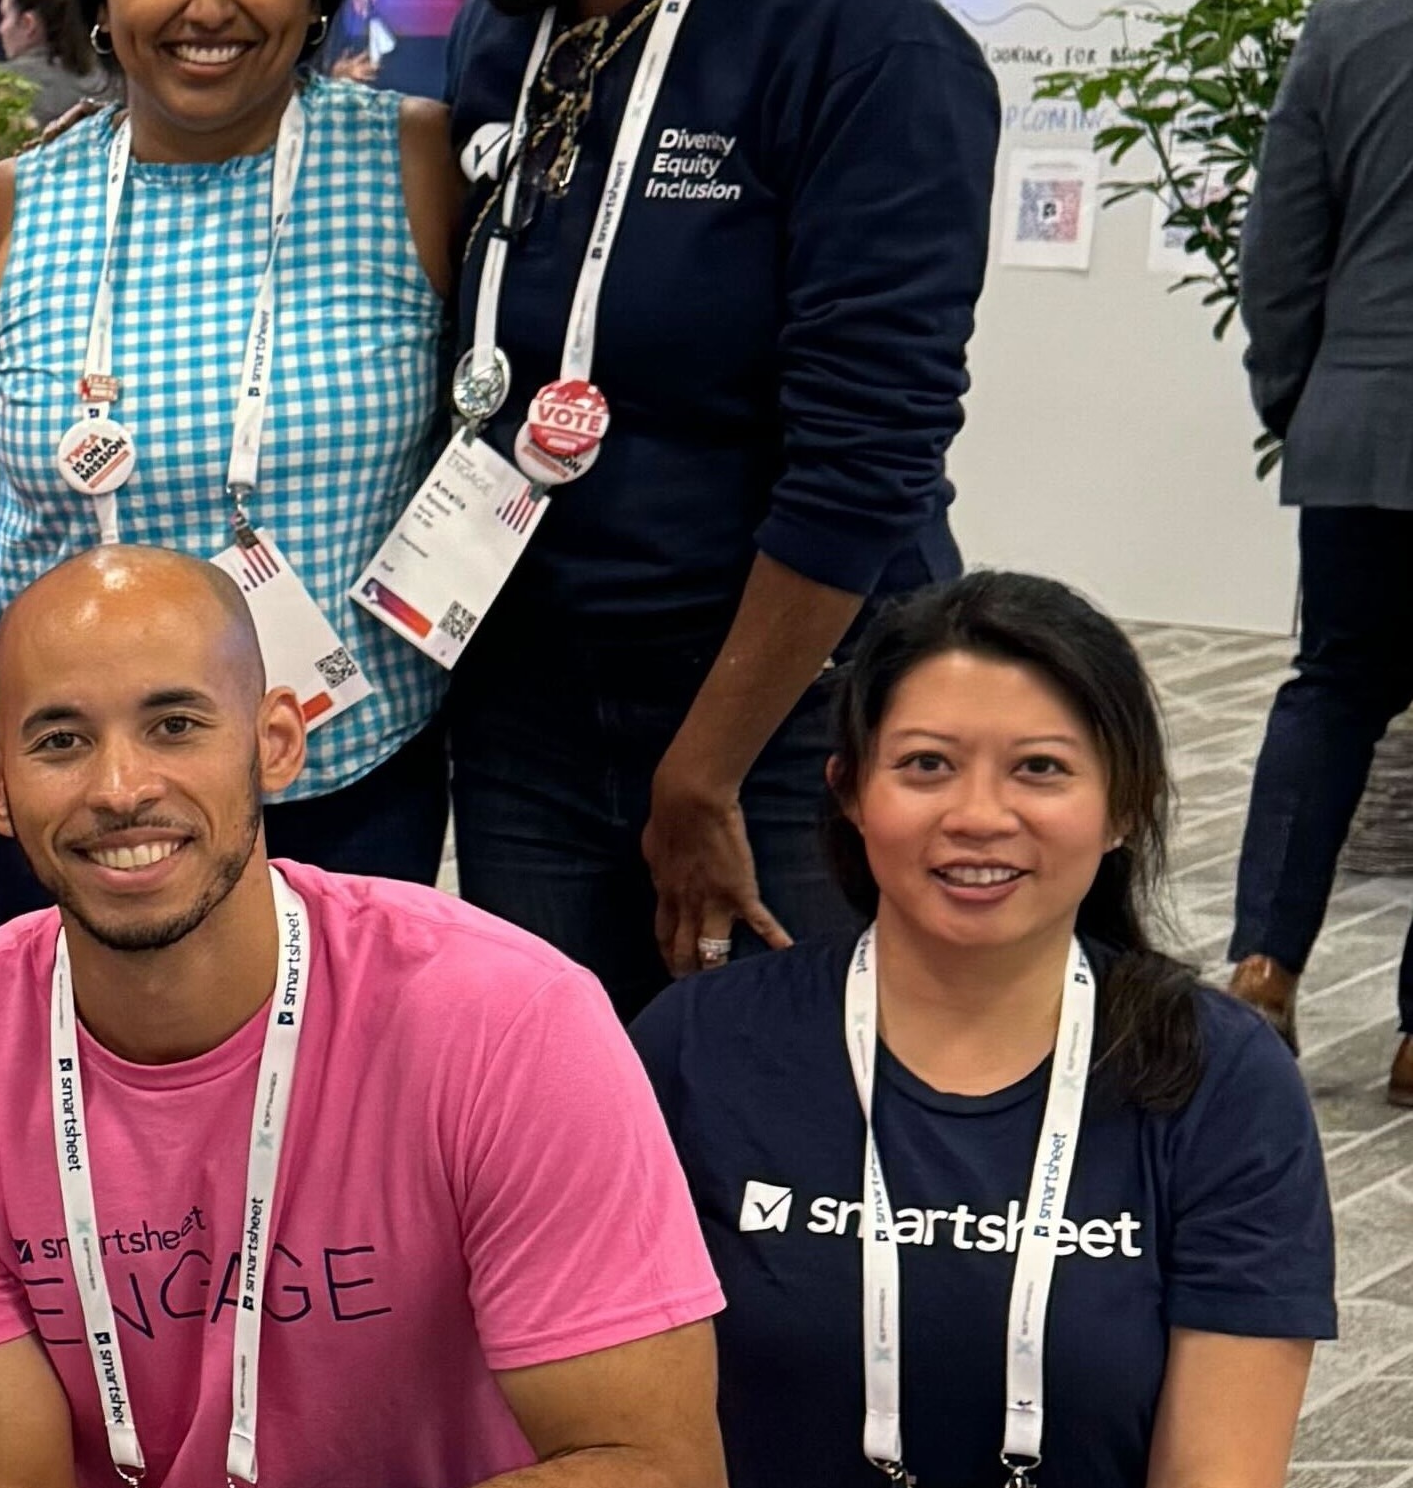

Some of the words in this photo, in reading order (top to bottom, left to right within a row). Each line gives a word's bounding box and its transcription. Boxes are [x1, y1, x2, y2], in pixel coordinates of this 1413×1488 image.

[652, 152, 722, 179] Equity
[644, 177, 741, 200] Inclusion
[537, 403, 603, 433] VOTE
[283, 911, 301, 1006] smartsheet
[61, 1077, 82, 1172] smartsheet
[41, 1205, 206, 1259] srtsheet
